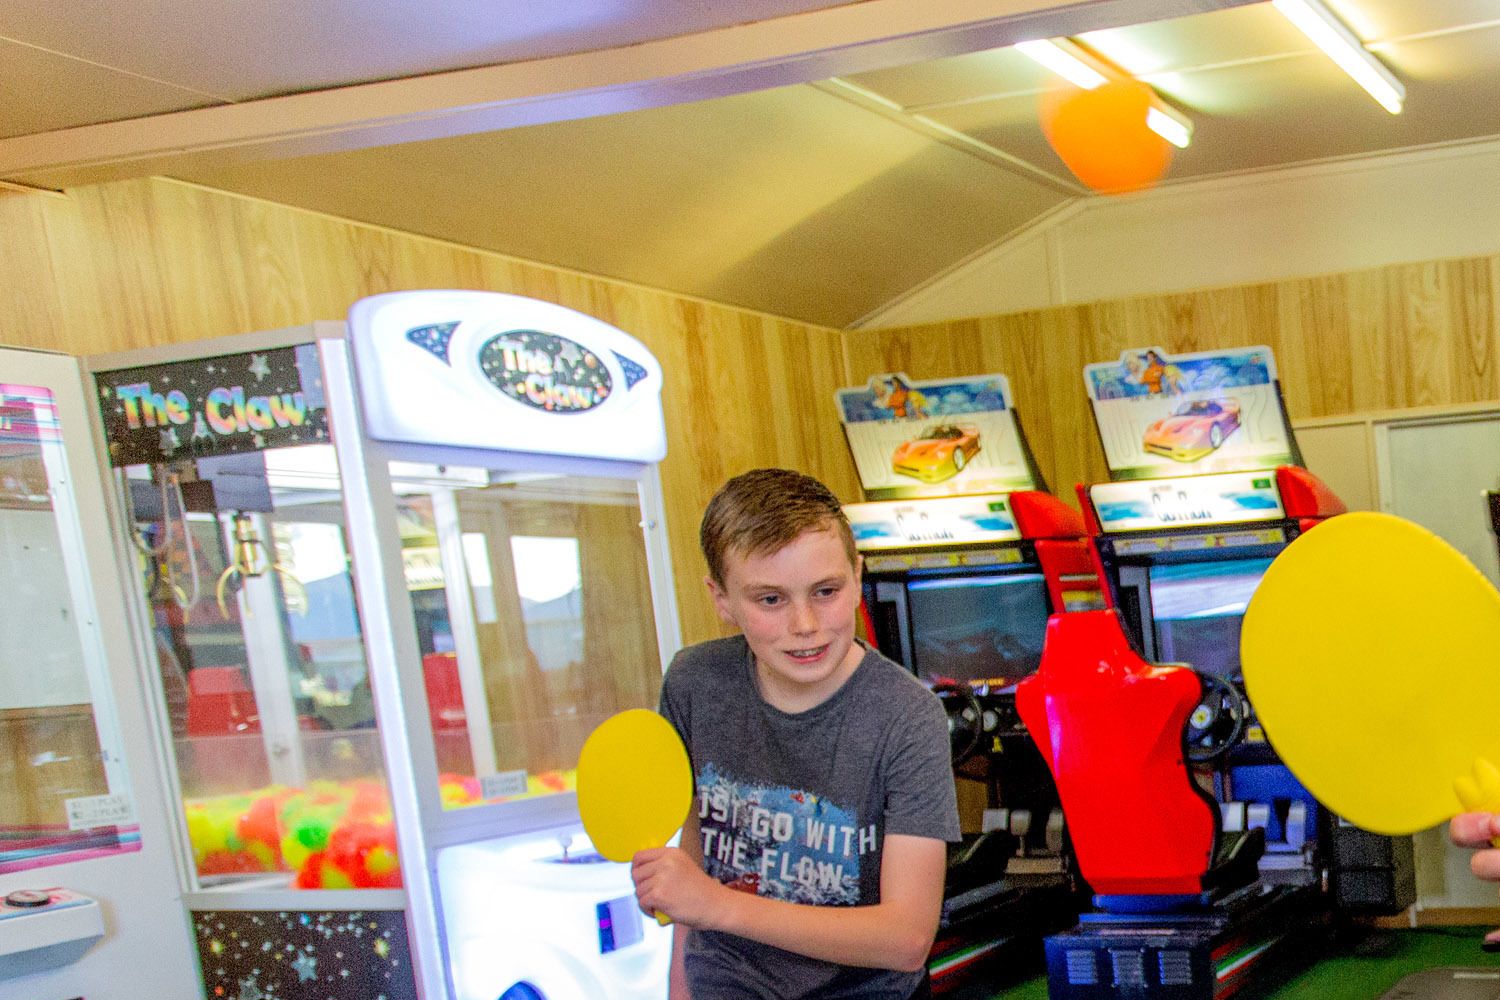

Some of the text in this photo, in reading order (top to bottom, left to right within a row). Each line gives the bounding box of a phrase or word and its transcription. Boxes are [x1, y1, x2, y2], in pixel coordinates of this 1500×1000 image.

[498, 339, 553, 376] The
[116, 381, 307, 436] The Claw
[524, 373, 593, 409] Claw
[751, 806, 794, 843] GO
[806, 817, 878, 857] WITH
[700, 827, 844, 892] THE FLOW
